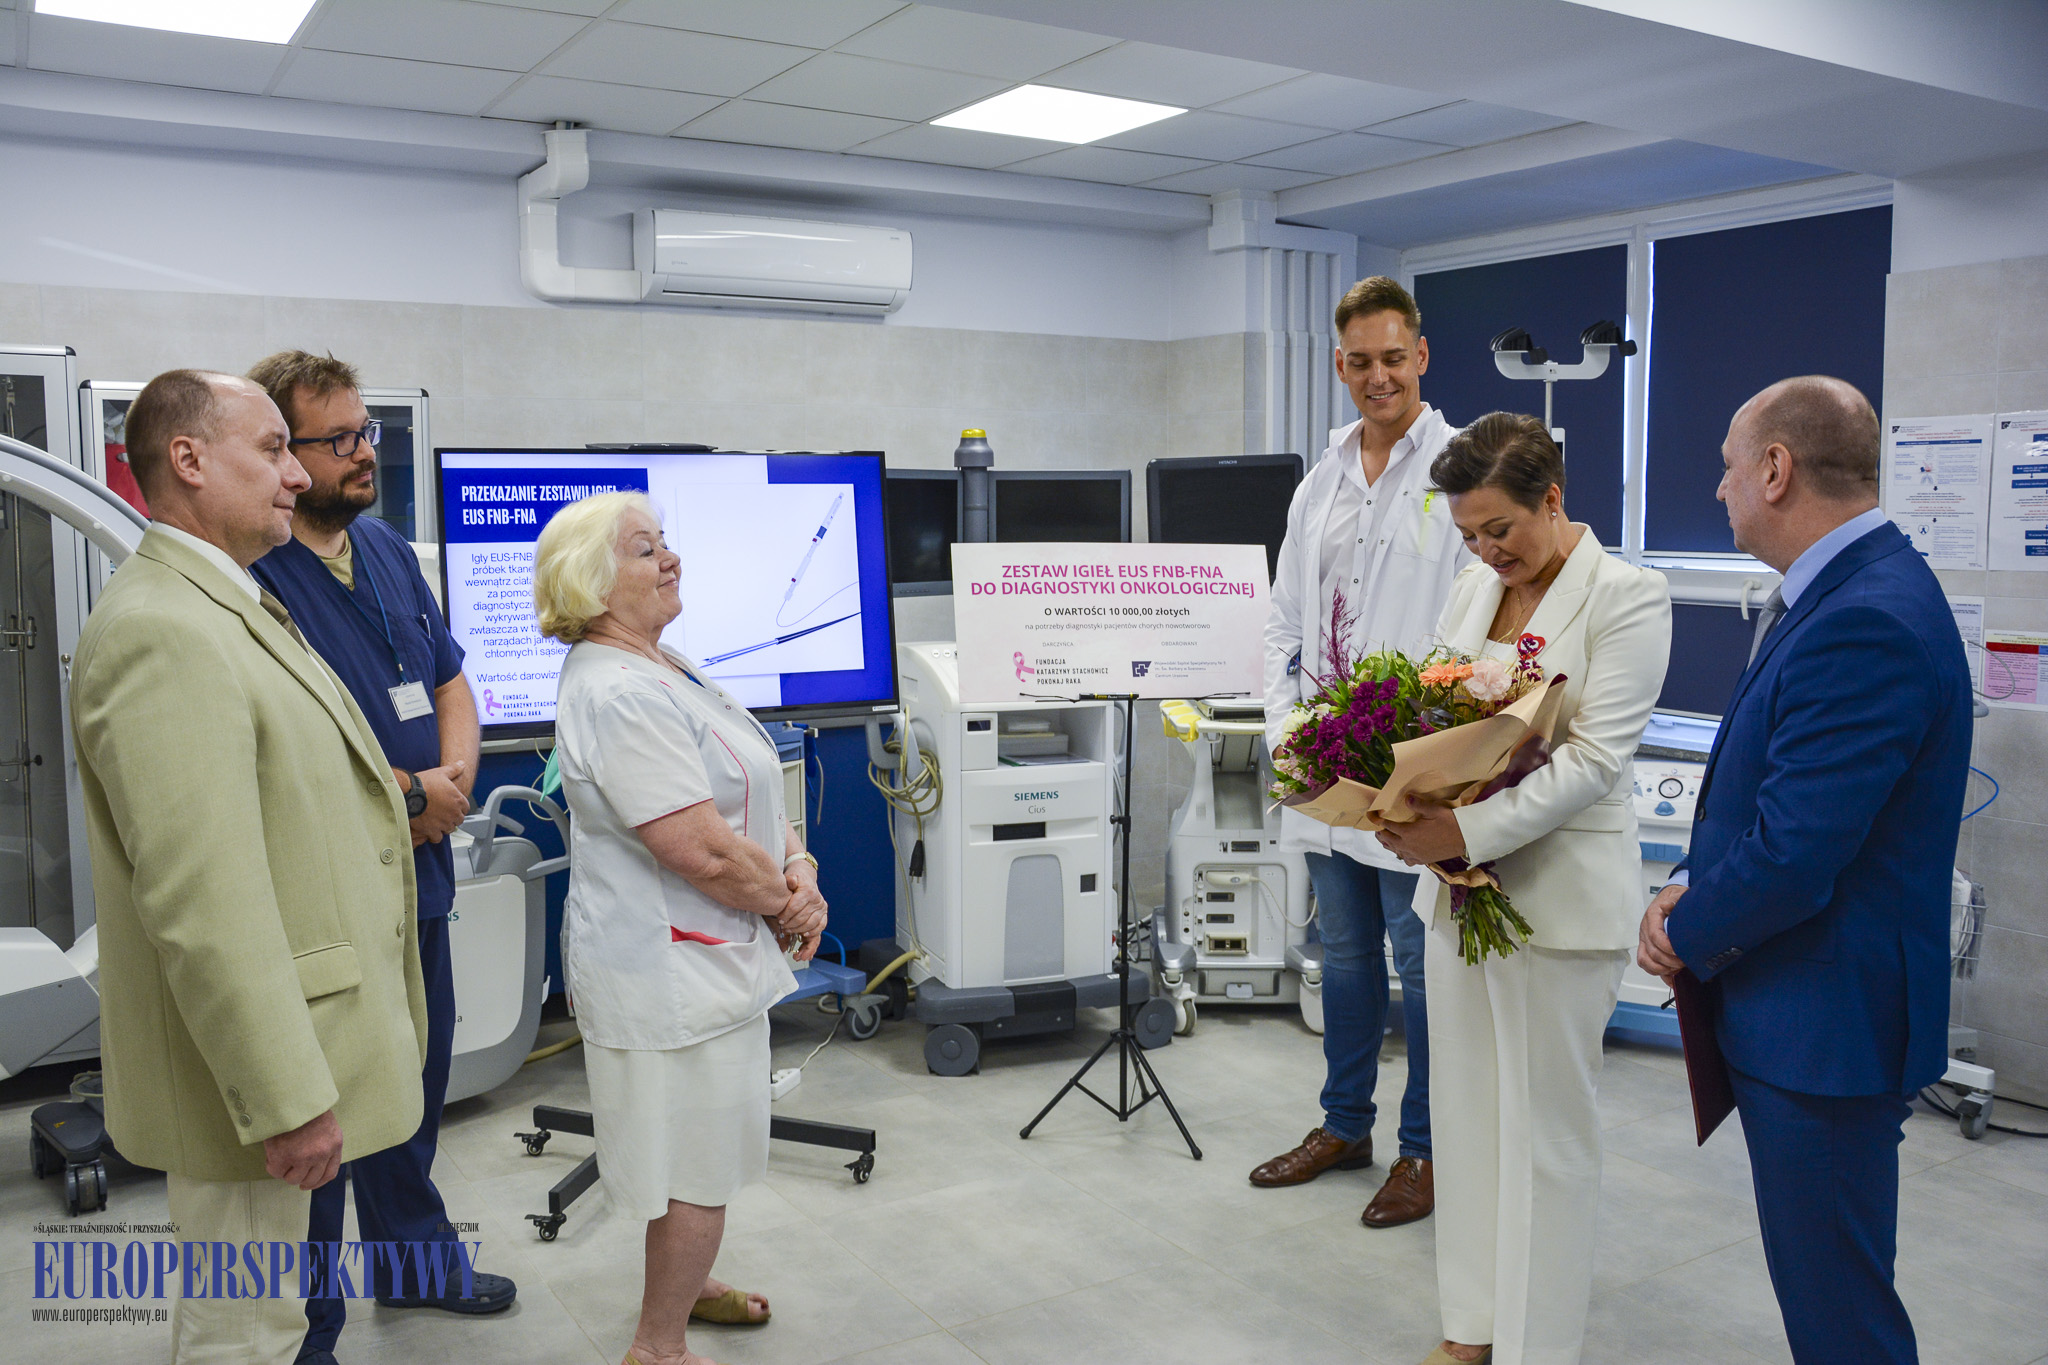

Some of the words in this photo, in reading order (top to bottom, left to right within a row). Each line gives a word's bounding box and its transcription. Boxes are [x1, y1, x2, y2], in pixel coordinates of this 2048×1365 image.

[461, 485, 537, 502] PRZEKAZANIE
[539, 485, 590, 501] ZESTAWU
[463, 509, 485, 525] EUS
[487, 508, 537, 525] FNB-FNA
[471, 553, 488, 565] Igły
[472, 565, 506, 575] próbek
[1002, 565, 1068, 578] ZESTAW
[1073, 565, 1114, 578] IGIEŁ
[1118, 565, 1148, 578] EUS
[1153, 565, 1224, 579] FNB-FNA
[465, 578, 511, 588] wewnątrz
[971, 582, 996, 595] DO
[1002, 581, 1115, 595] DIAGNOSTYKI
[1120, 581, 1255, 599] ONKOLOGICZNEJ
[1044, 607, 1052, 616] O
[1054, 606, 1106, 616] WARTOŚCI
[1109, 607, 1120, 616] 10
[1122, 607, 1153, 617] 000,00
[1155, 607, 1190, 617] złotych
[469, 625, 518, 635] zwłaszcza
[1035, 623, 1064, 631] potrzeby
[1066, 622, 1103, 630] diagnostyki
[1104, 622, 1137, 630] pacjentów
[1138, 623, 1164, 631] chorych
[483, 636, 532, 647] narządach
[484, 646, 533, 659] chłonnych
[476, 672, 518, 683] Wartość
[1014, 791, 1059, 801] SIEMENS
